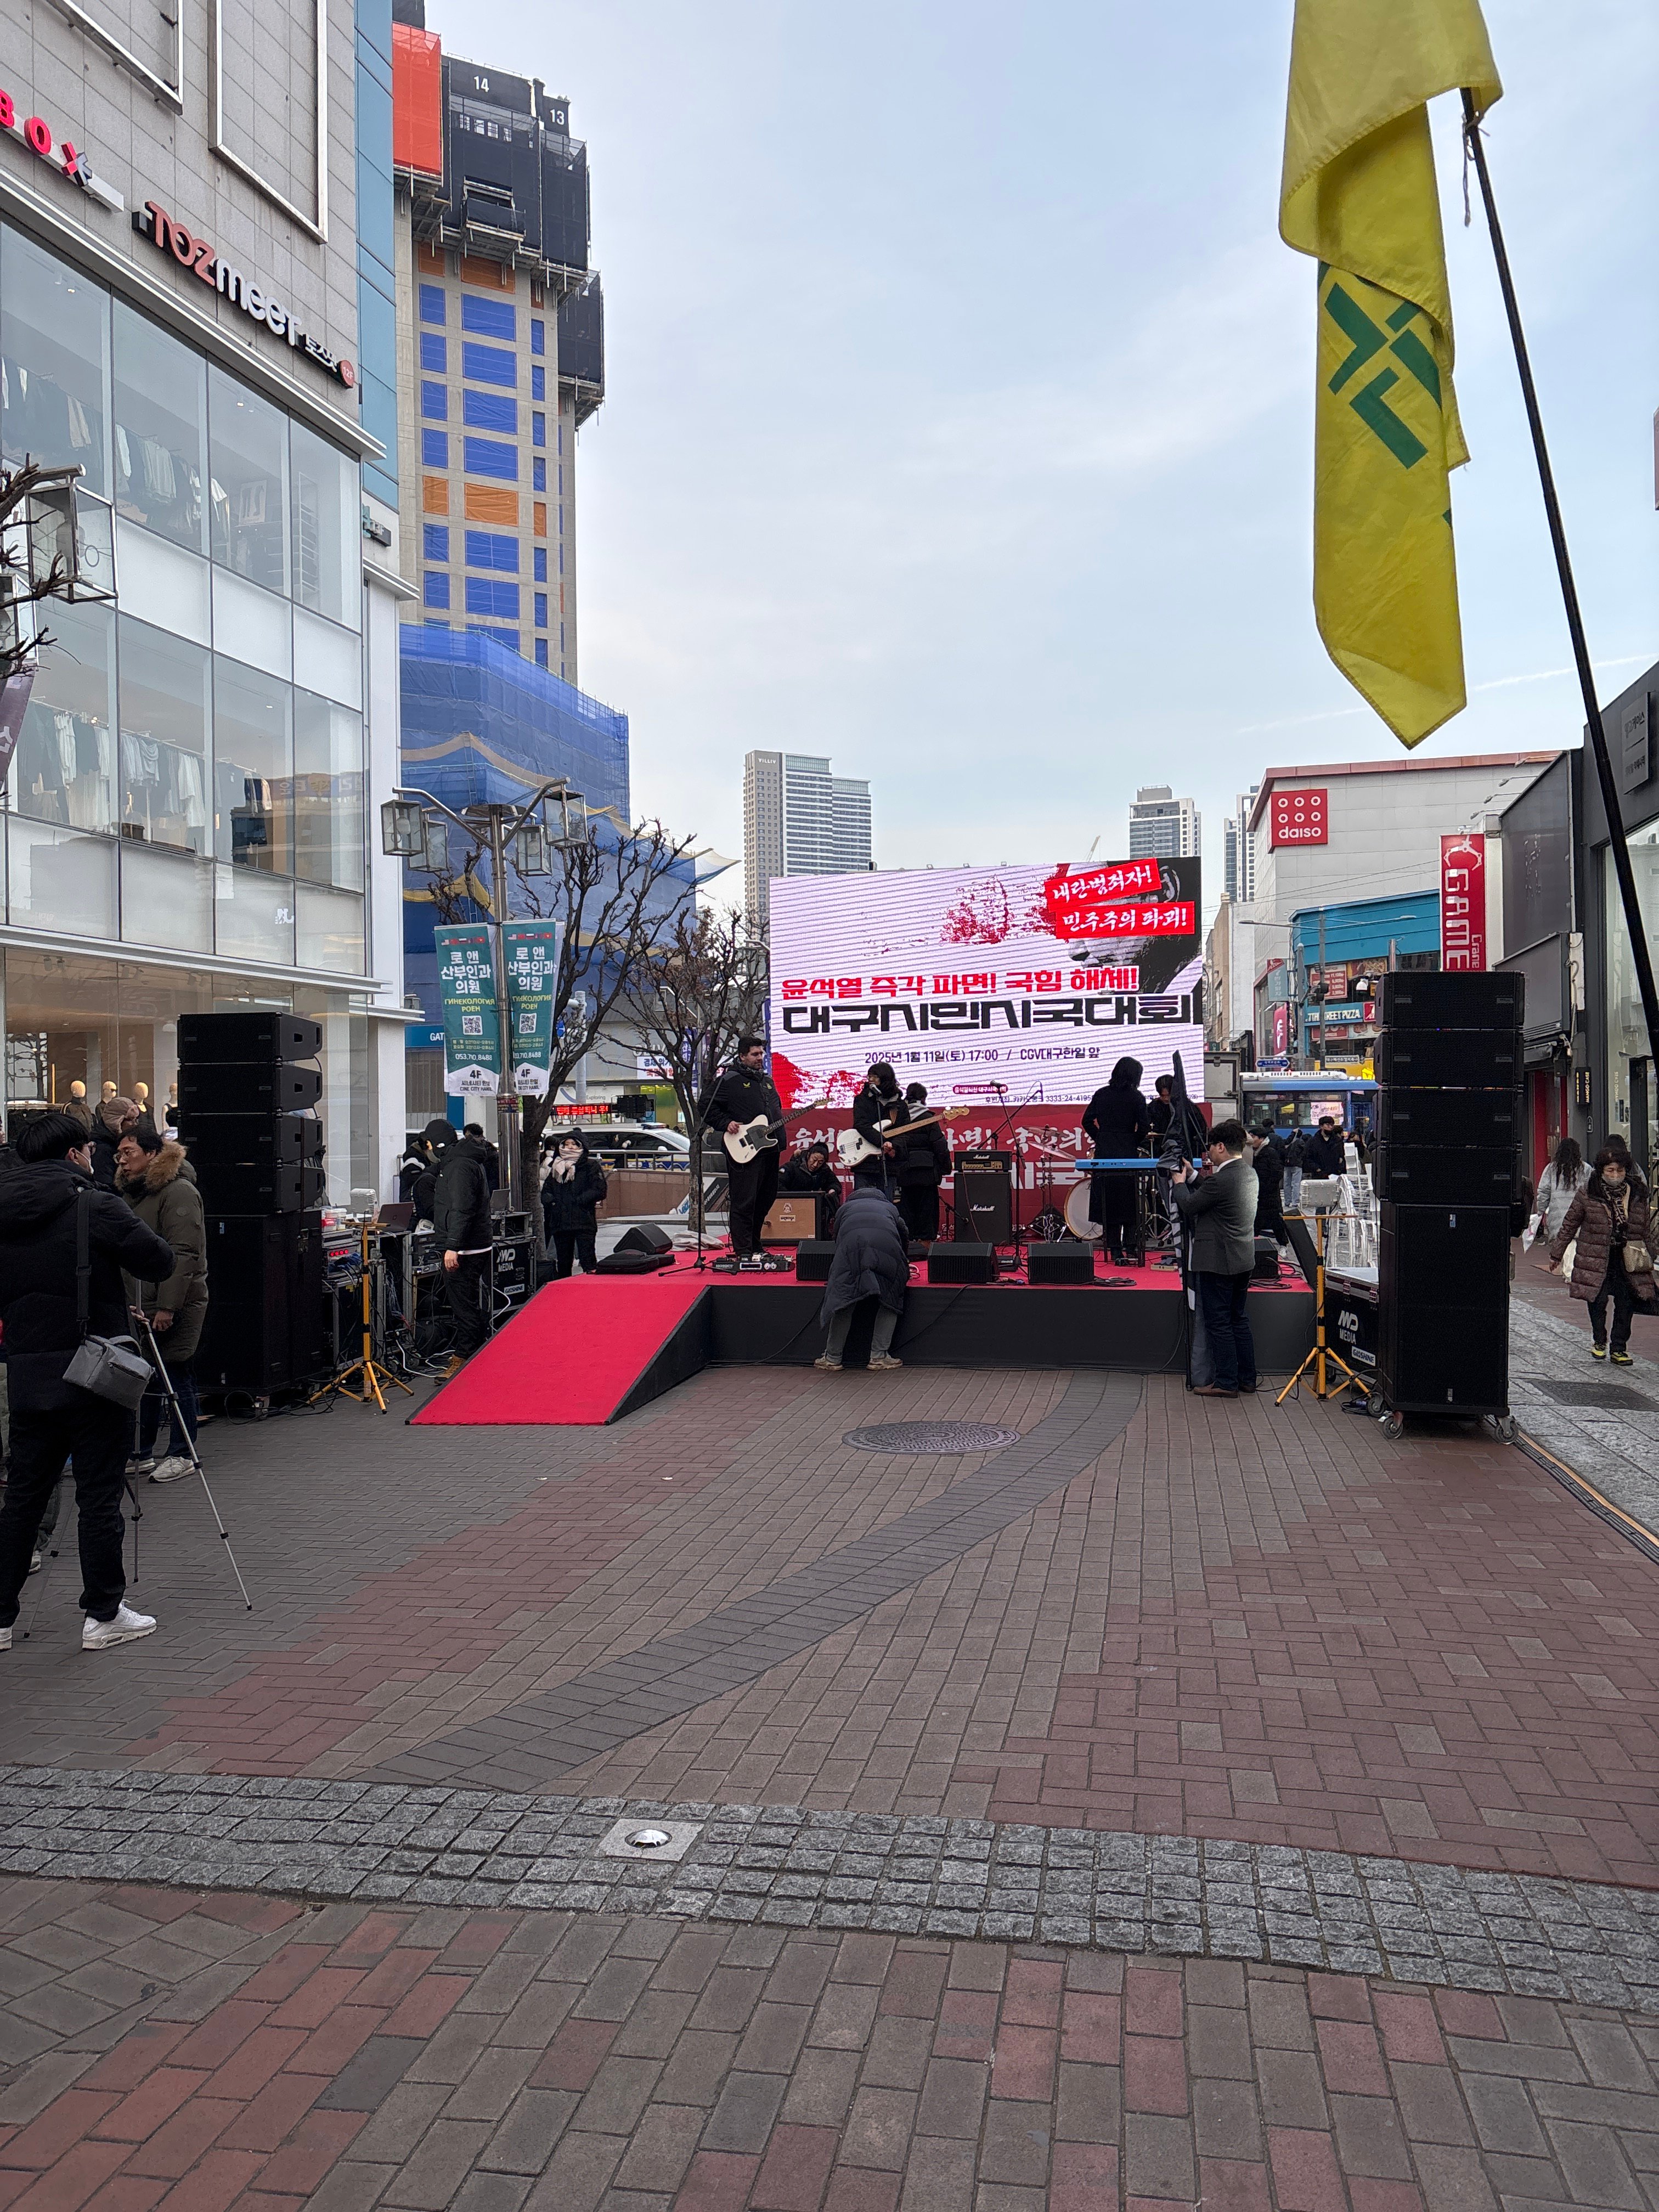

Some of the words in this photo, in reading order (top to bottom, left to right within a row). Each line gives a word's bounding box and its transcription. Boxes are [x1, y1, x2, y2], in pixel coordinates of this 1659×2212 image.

[473, 76, 489, 93] 14
[550, 109, 565, 126] 13
[343, 366, 354, 380] 12F
[1278, 826, 1322, 839] daiso
[1052, 865, 1153, 903] 내란범죄자!
[1062, 909, 1136, 932] 민주주의
[1142, 907, 1187, 930] 파괴!
[1444, 868, 1470, 969] GAME
[1471, 934, 1482, 968] Crane
[441, 964, 492, 980] 산부인과
[508, 960, 554, 975] 산부인과
[455, 980, 481, 994] 의원
[518, 976, 543, 991] 의원
[782, 978, 862, 1000] 윤석열
[870, 975, 926, 997] 즉각
[932, 973, 996, 995] 파면!
[1005, 970, 1062, 993] 국힘
[1070, 967, 1137, 991] 해체!
[783, 994, 1191, 1034] 대구시민시국대회
[1342, 1009, 1361, 1019] PIZZA
[865, 1051, 902, 1064] 2025년
[905, 1052, 921, 1063] 1월
[923, 1050, 966, 1063] 11일(토)
[969, 1049, 998, 1062] 17:00
[1020, 1047, 1086, 1060] CGV대구한일
[1088, 1047, 1101, 1058] 앞
[470, 1070, 482, 1079] 4F
[521, 1069, 531, 1077] 4F
[1339, 1328, 1357, 1345] MEDIA
